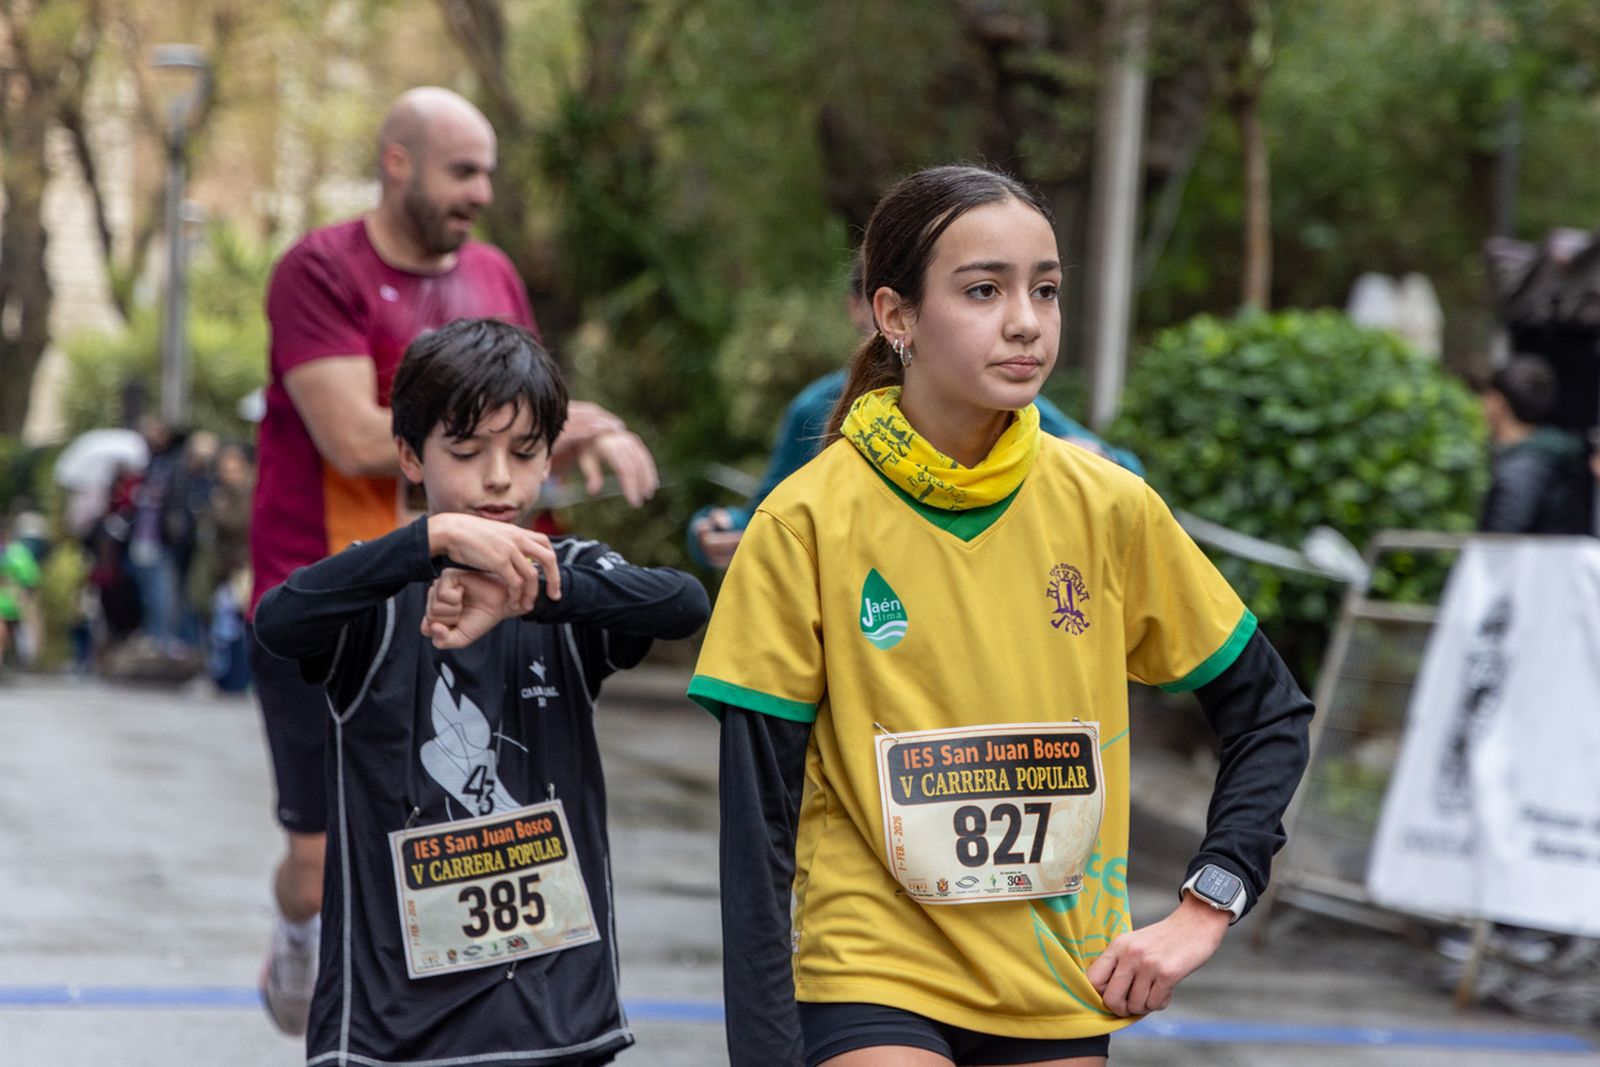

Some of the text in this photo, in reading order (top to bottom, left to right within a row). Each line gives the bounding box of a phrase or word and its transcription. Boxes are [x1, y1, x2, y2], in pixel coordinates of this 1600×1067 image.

[862, 597, 901, 627] Jaén
[873, 612, 902, 622] clima
[903, 738, 1080, 769] IES San Juan Bosco
[899, 766, 1089, 798] V CARRERA POPULAR
[414, 816, 553, 859] IES San Juan Bosco
[953, 802, 1052, 868] 827
[411, 837, 563, 885] V CARRERA POPULAR
[458, 873, 545, 939] 385
